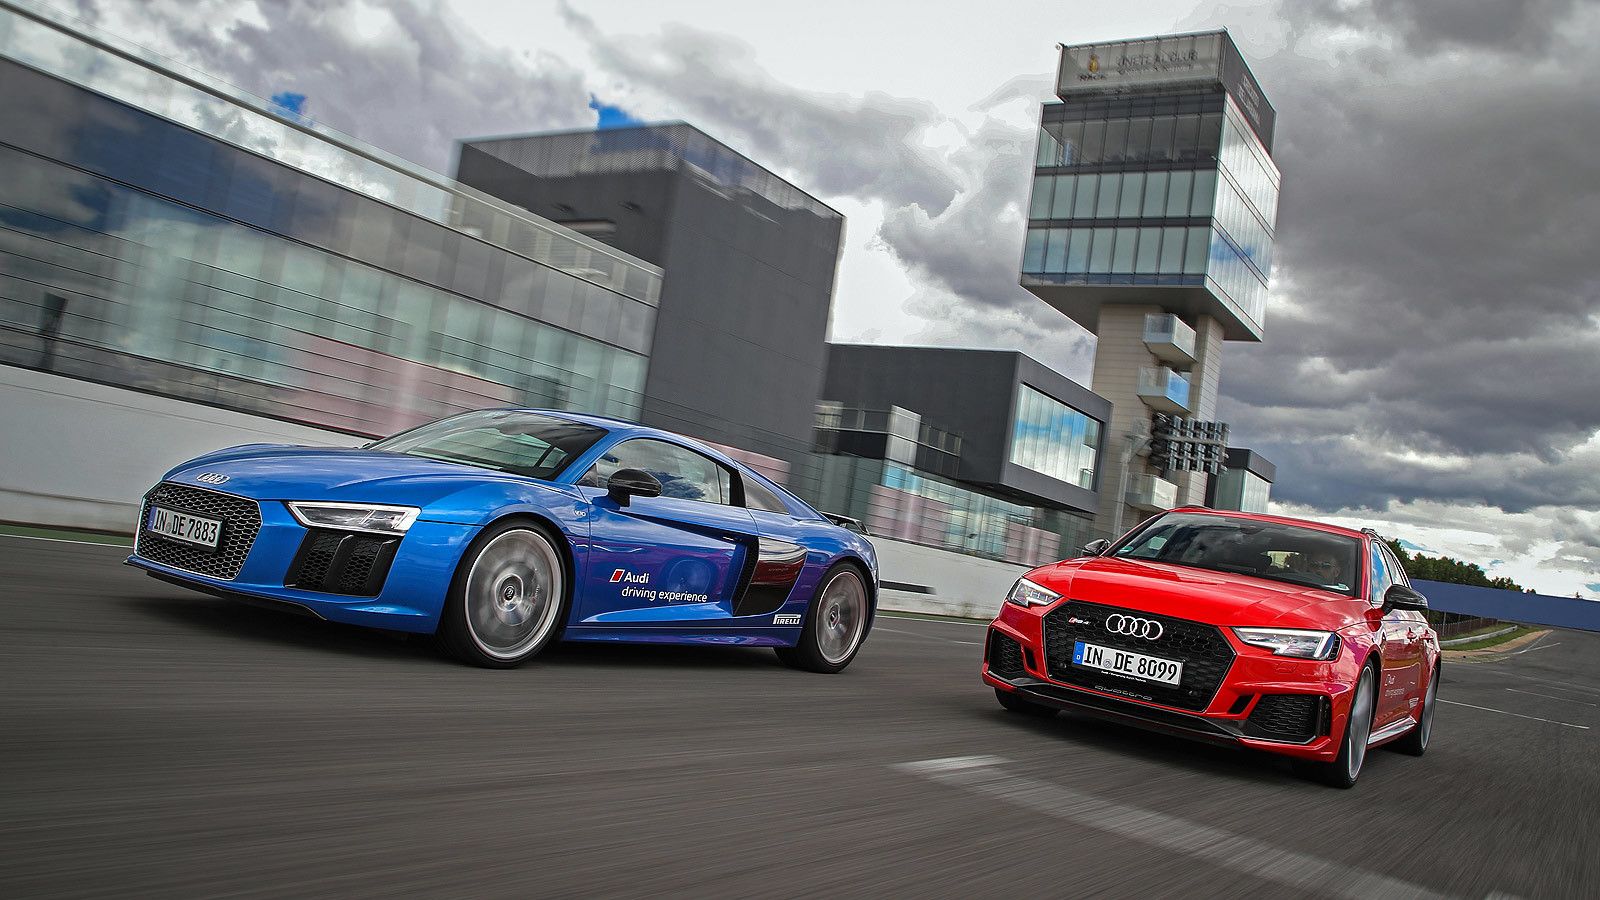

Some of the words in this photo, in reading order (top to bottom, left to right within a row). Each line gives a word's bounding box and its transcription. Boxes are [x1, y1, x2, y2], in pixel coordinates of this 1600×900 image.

[154, 510, 168, 531] IN
[172, 515, 187, 536] DE
[187, 519, 218, 543] 7883
[624, 572, 650, 584] Audi
[621, 586, 656, 601] driving
[658, 591, 708, 603] experience
[772, 613, 802, 625] PIRELLI
[1084, 646, 1104, 666] IN
[1113, 652, 1135, 673] DE
[1137, 657, 1178, 681] 8099
[1094, 685, 1153, 701] quattro
